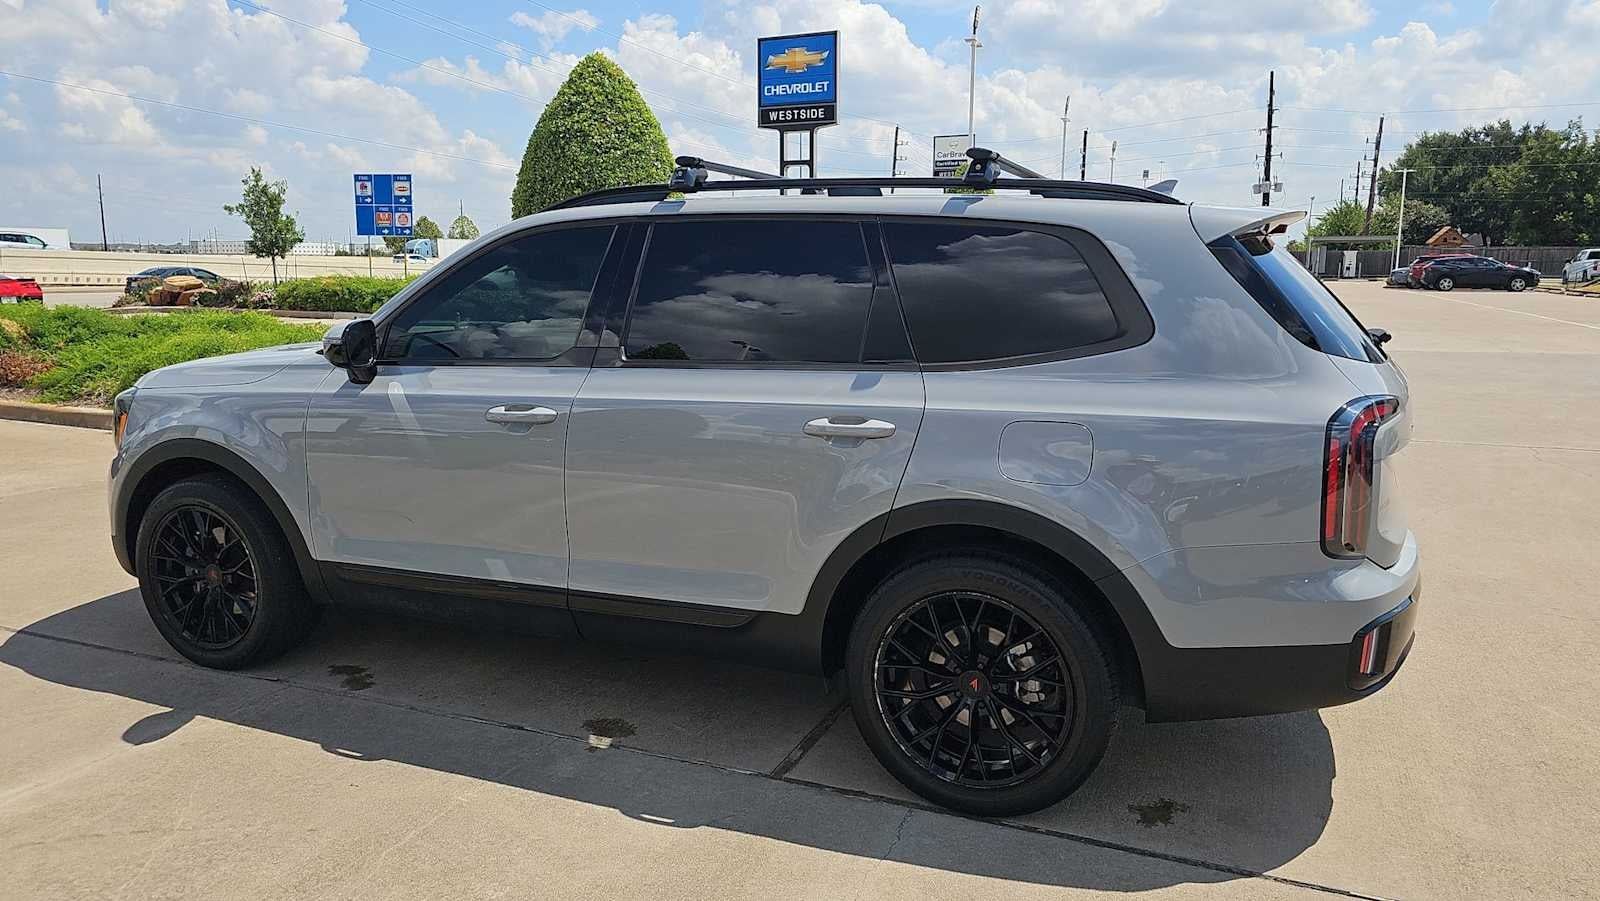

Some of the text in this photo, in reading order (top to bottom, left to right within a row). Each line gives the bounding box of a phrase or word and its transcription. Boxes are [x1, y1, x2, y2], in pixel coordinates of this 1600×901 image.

[764, 81, 830, 96] CHEVROLET
[769, 108, 825, 121] WESTSIDE
[936, 151, 967, 159] CarBrav
